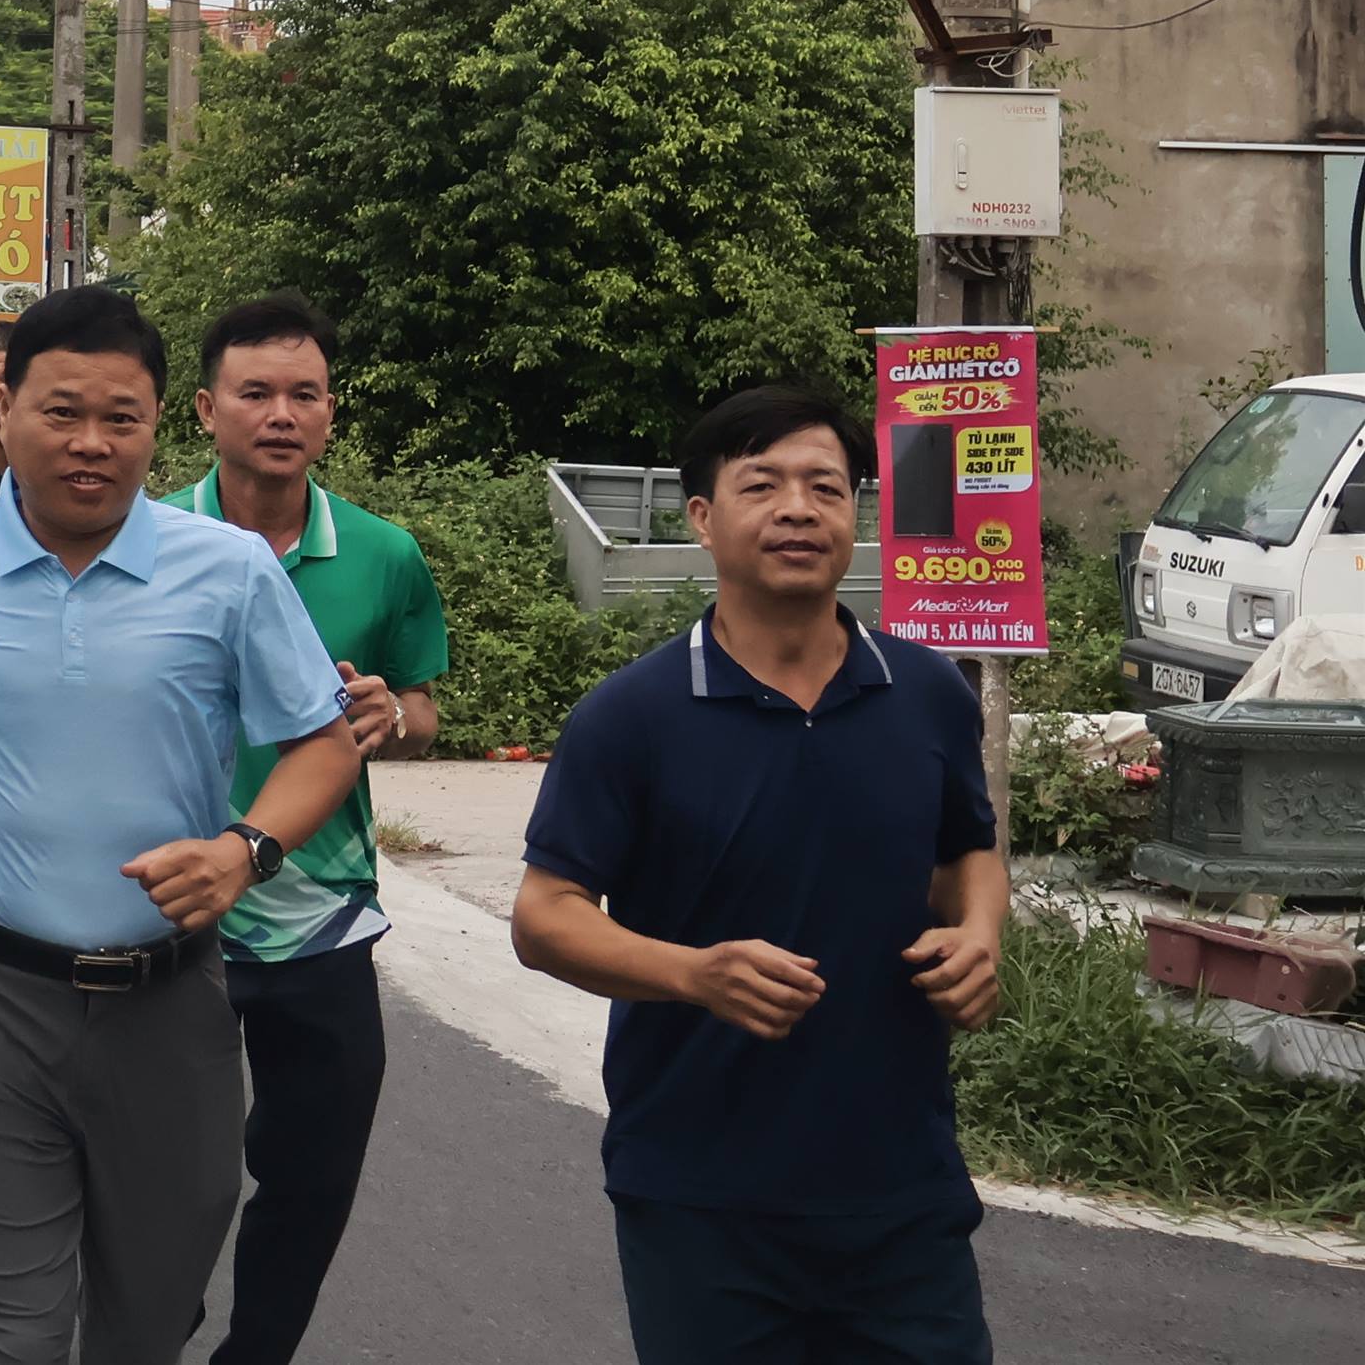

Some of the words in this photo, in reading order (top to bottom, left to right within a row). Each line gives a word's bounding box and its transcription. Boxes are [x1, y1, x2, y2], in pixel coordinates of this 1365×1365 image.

[971, 202, 1032, 214] NDH0232
[908, 346, 931, 363] HÈ
[973, 342, 1000, 360] RỠ
[889, 361, 947, 382] GIẢM
[949, 359, 988, 379] HẾT
[988, 357, 1021, 377] CỠ
[914, 391, 939, 402] GIẢM
[942, 386, 1002, 412] 50%
[919, 403, 938, 412] ĐẾN
[968, 430, 982, 445] TỦ
[986, 433, 1015, 446] LẠNH
[967, 448, 987, 457] SIDE
[990, 448, 1002, 457] BY
[1005, 447, 1024, 456] SIDE
[965, 461, 993, 474] 430
[997, 458, 1016, 473] LÍT
[982, 536, 1007, 547] 50%
[894, 555, 991, 582] 9.690
[1170, 551, 1225, 578] SUZUKI
[993, 571, 1026, 582] VNĐ
[889, 619, 927, 641] THÔN
[931, 624, 945, 642] 5,
[948, 620, 968, 641] XÃ
[972, 618, 997, 641] HẢI
[1000, 619, 1035, 642] TIẾN
